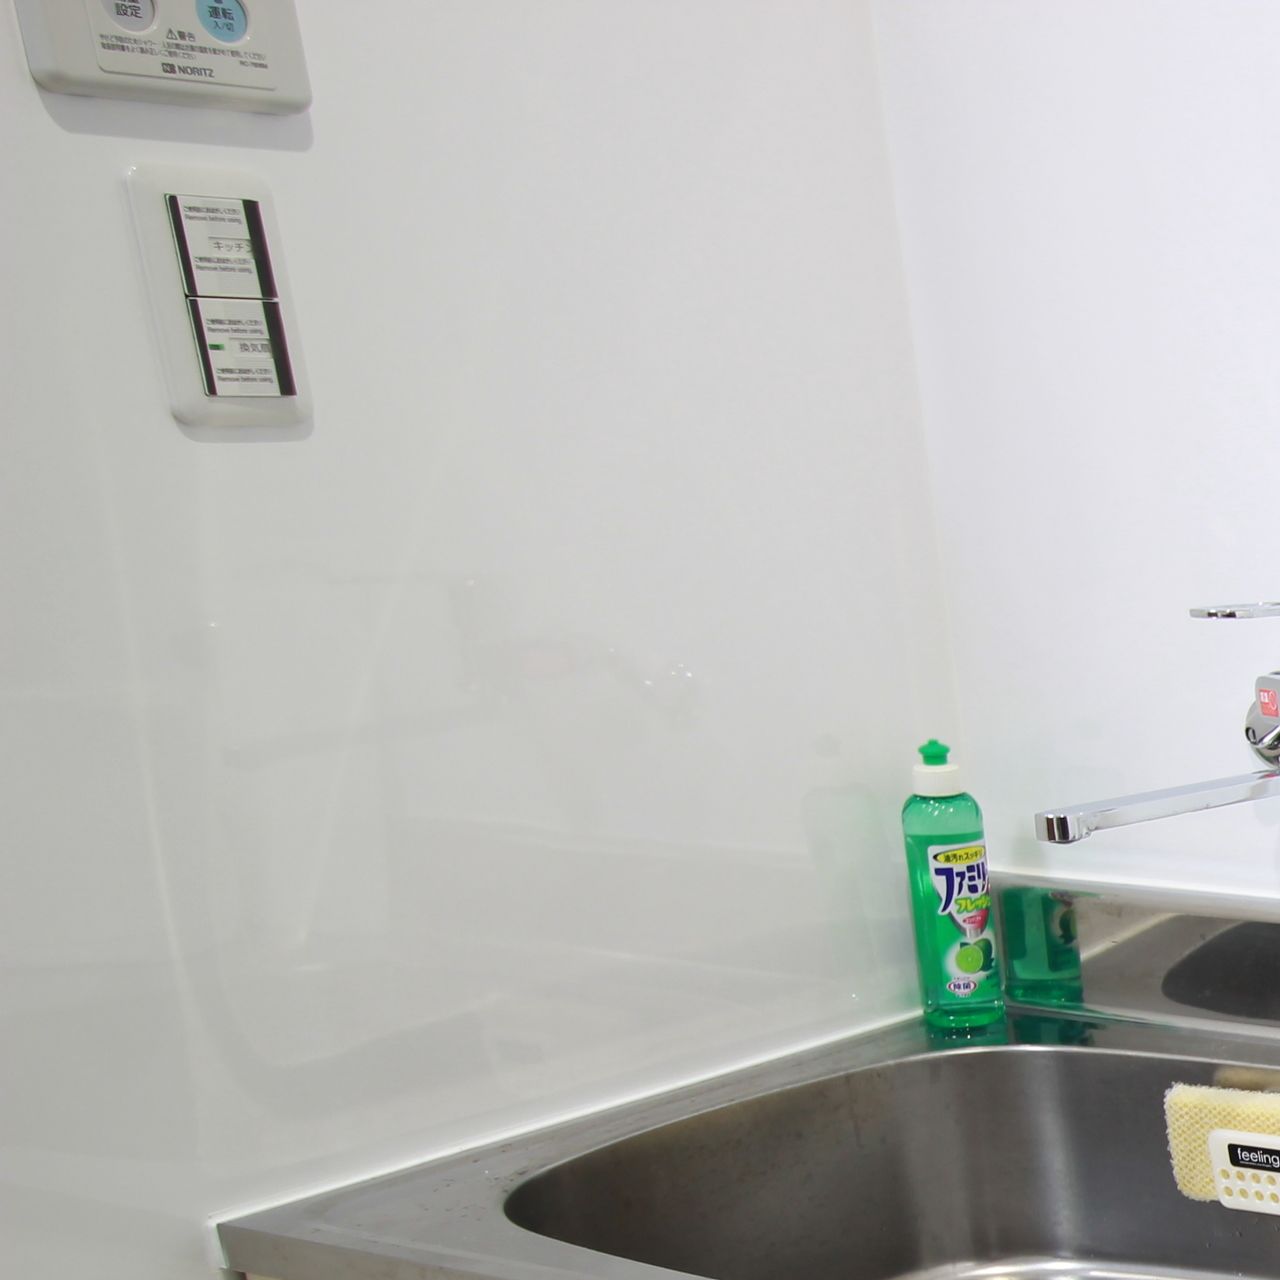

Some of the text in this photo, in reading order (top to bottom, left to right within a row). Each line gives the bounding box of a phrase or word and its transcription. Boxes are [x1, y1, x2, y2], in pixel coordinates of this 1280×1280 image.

[115, 3, 143, 19] 設定
[208, 5, 234, 21] 運転
[178, 65, 215, 78] NORITZ
[1237, 1147, 1280, 1168] feeling
